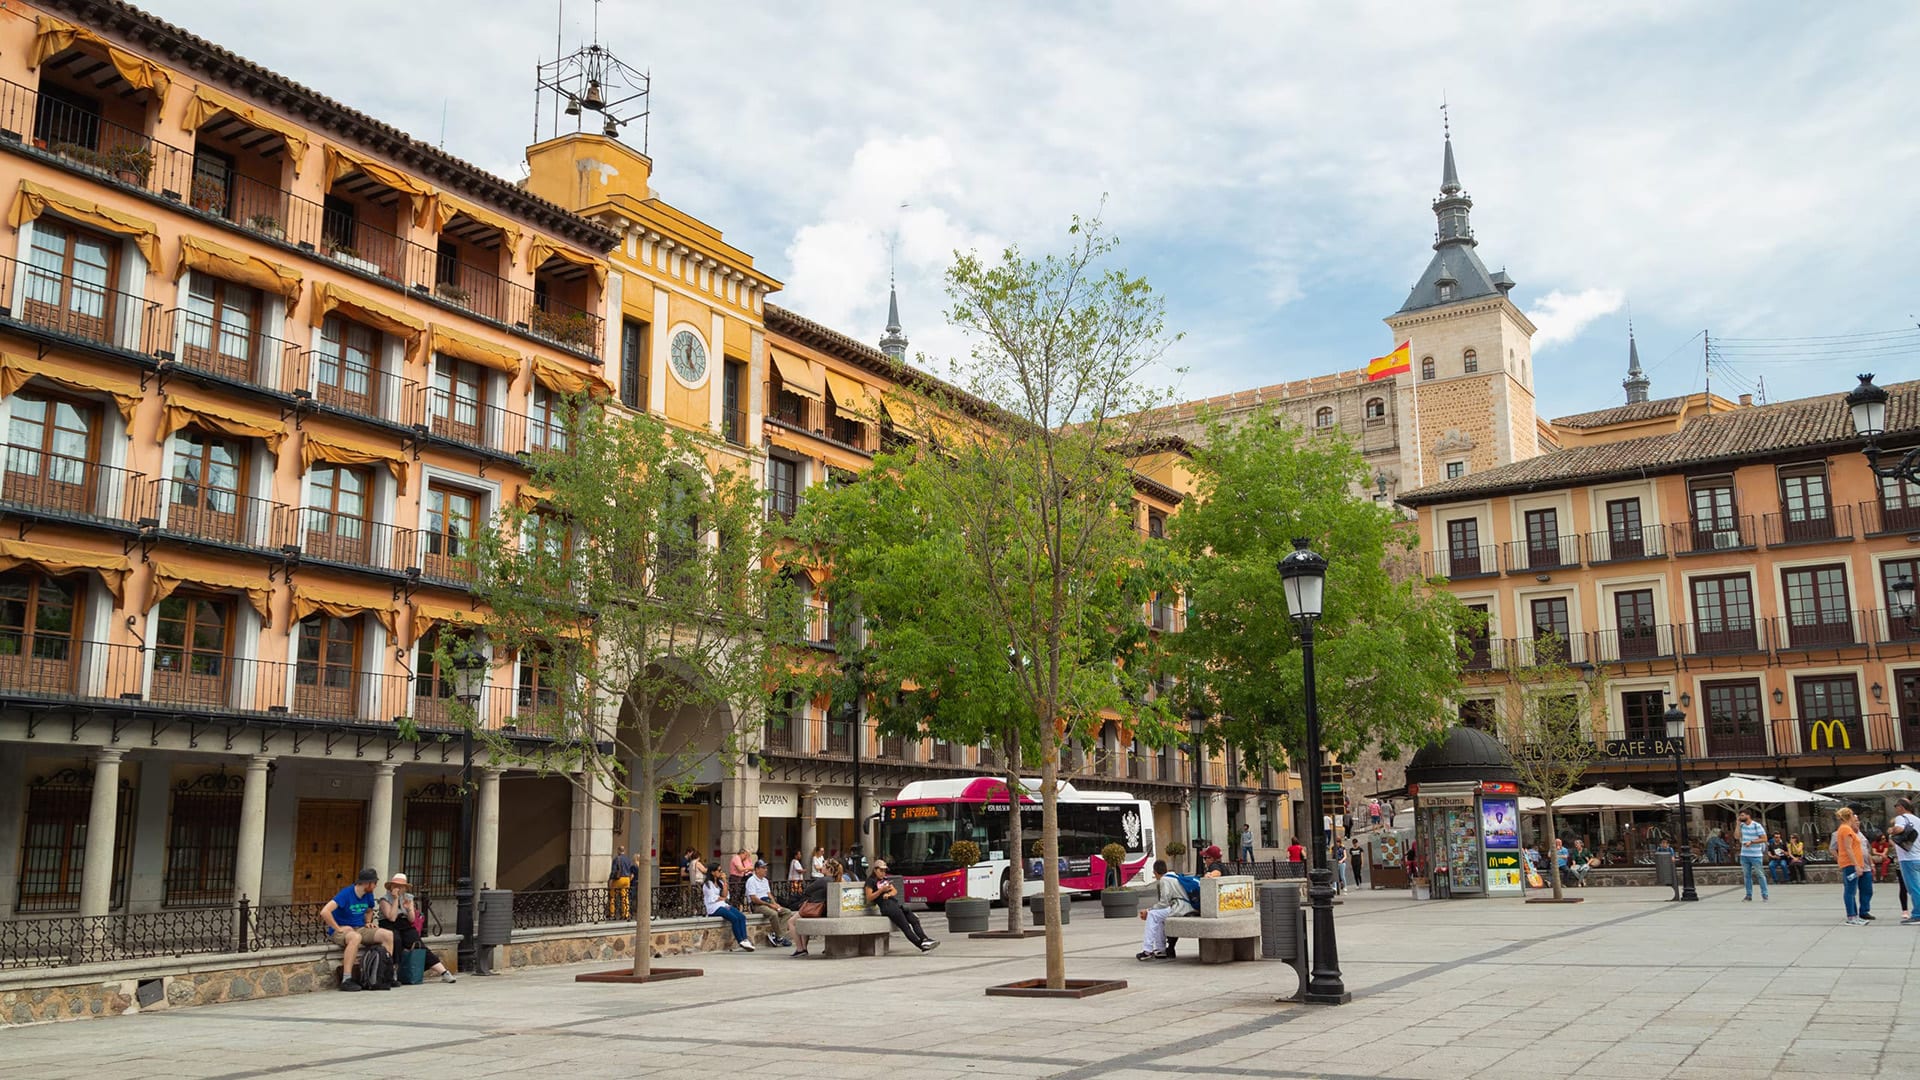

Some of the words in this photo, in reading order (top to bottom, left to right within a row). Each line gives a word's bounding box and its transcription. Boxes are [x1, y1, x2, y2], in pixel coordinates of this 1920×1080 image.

[1607, 741, 1646, 756] CAFE
[815, 797, 831, 806] ANTO
[890, 808, 897, 819] 5
